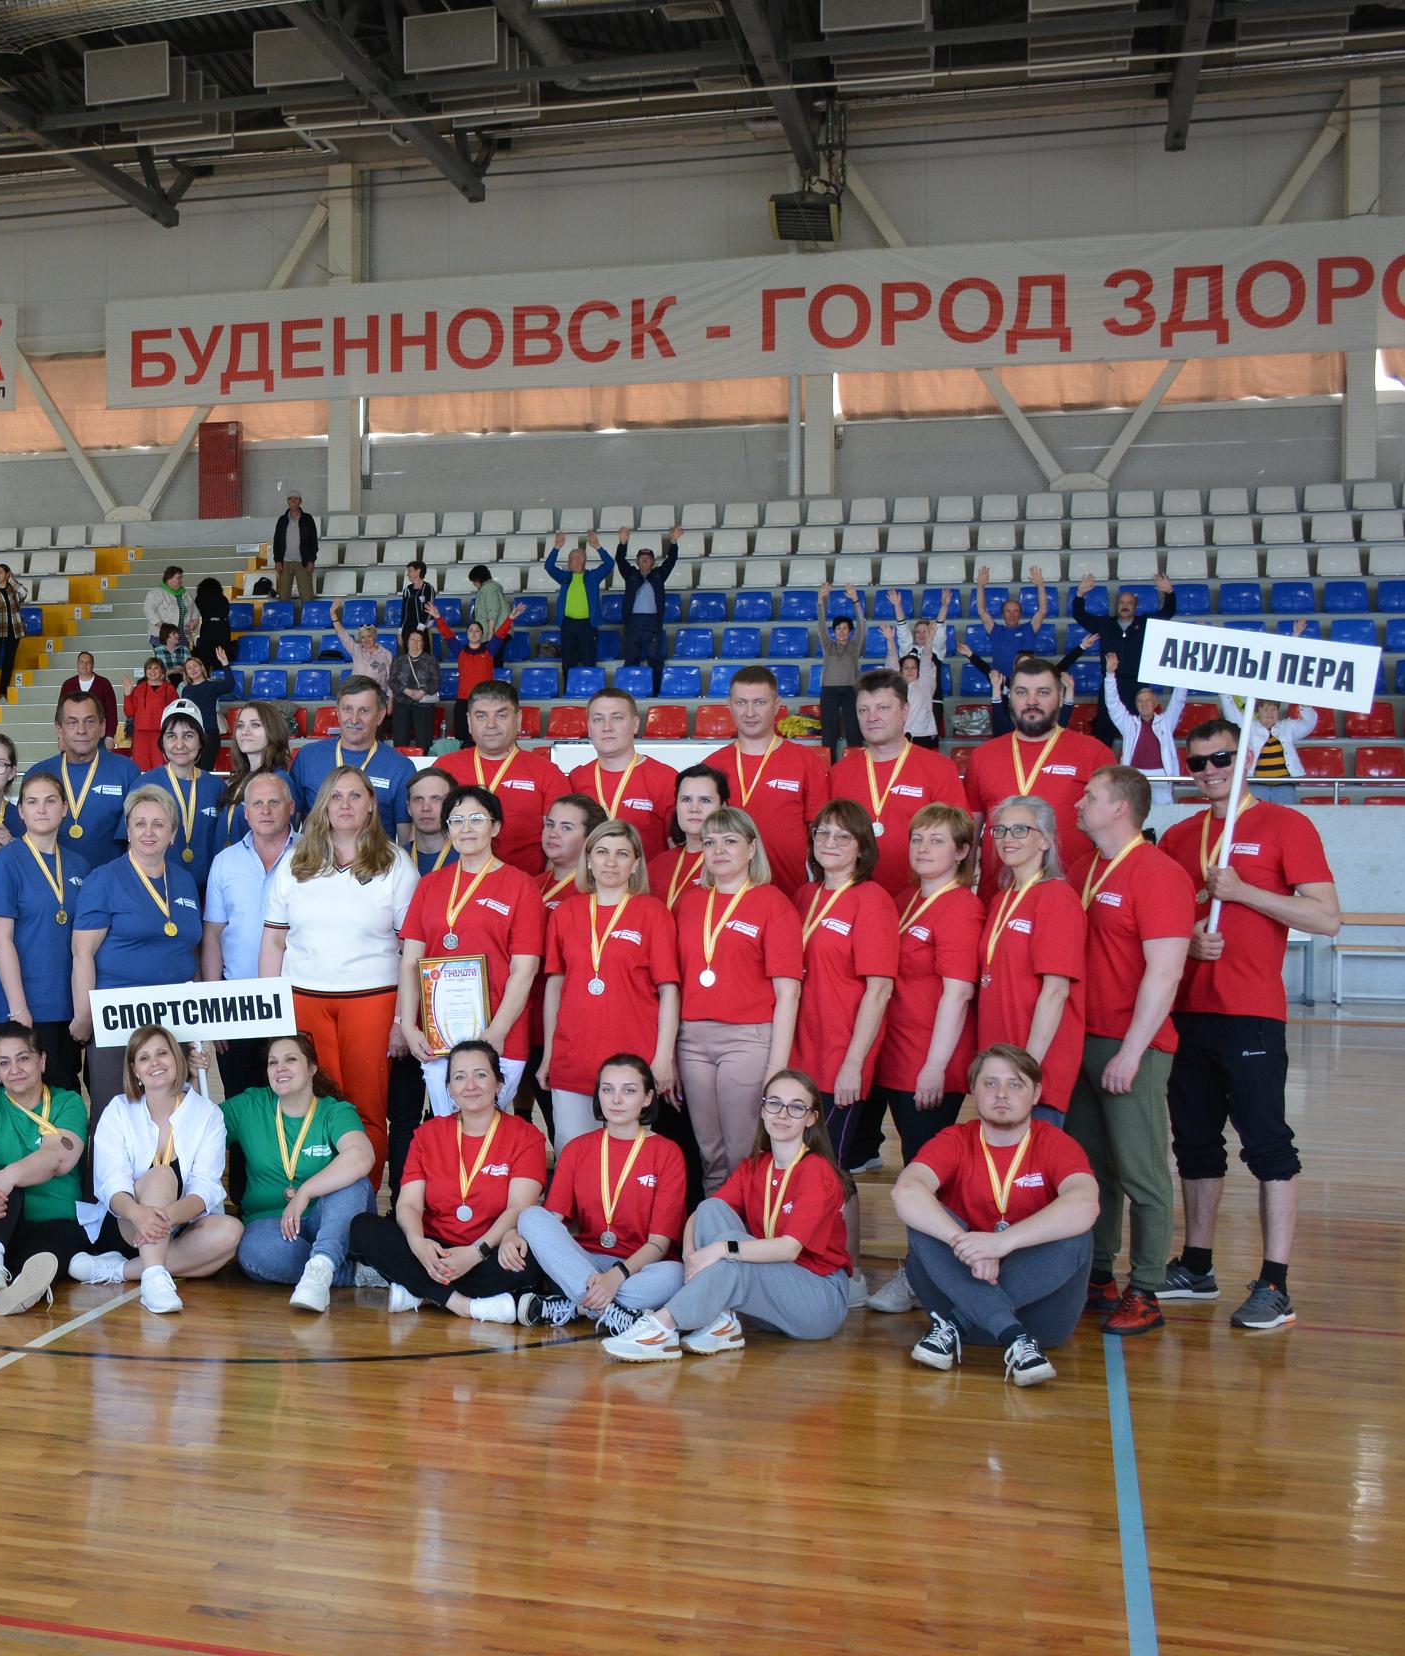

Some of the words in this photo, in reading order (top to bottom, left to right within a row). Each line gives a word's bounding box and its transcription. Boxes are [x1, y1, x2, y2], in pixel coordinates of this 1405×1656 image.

[131, 296, 677, 395] БУДЕННОВСК
[761, 273, 1072, 355] ГОРОД
[1158, 637, 1272, 681] АКУЛЫ
[1276, 653, 1355, 693] ПЕРА
[443, 968, 477, 978] ГРАМОТА
[102, 993, 283, 1031] СПОРТСМИНЫ
